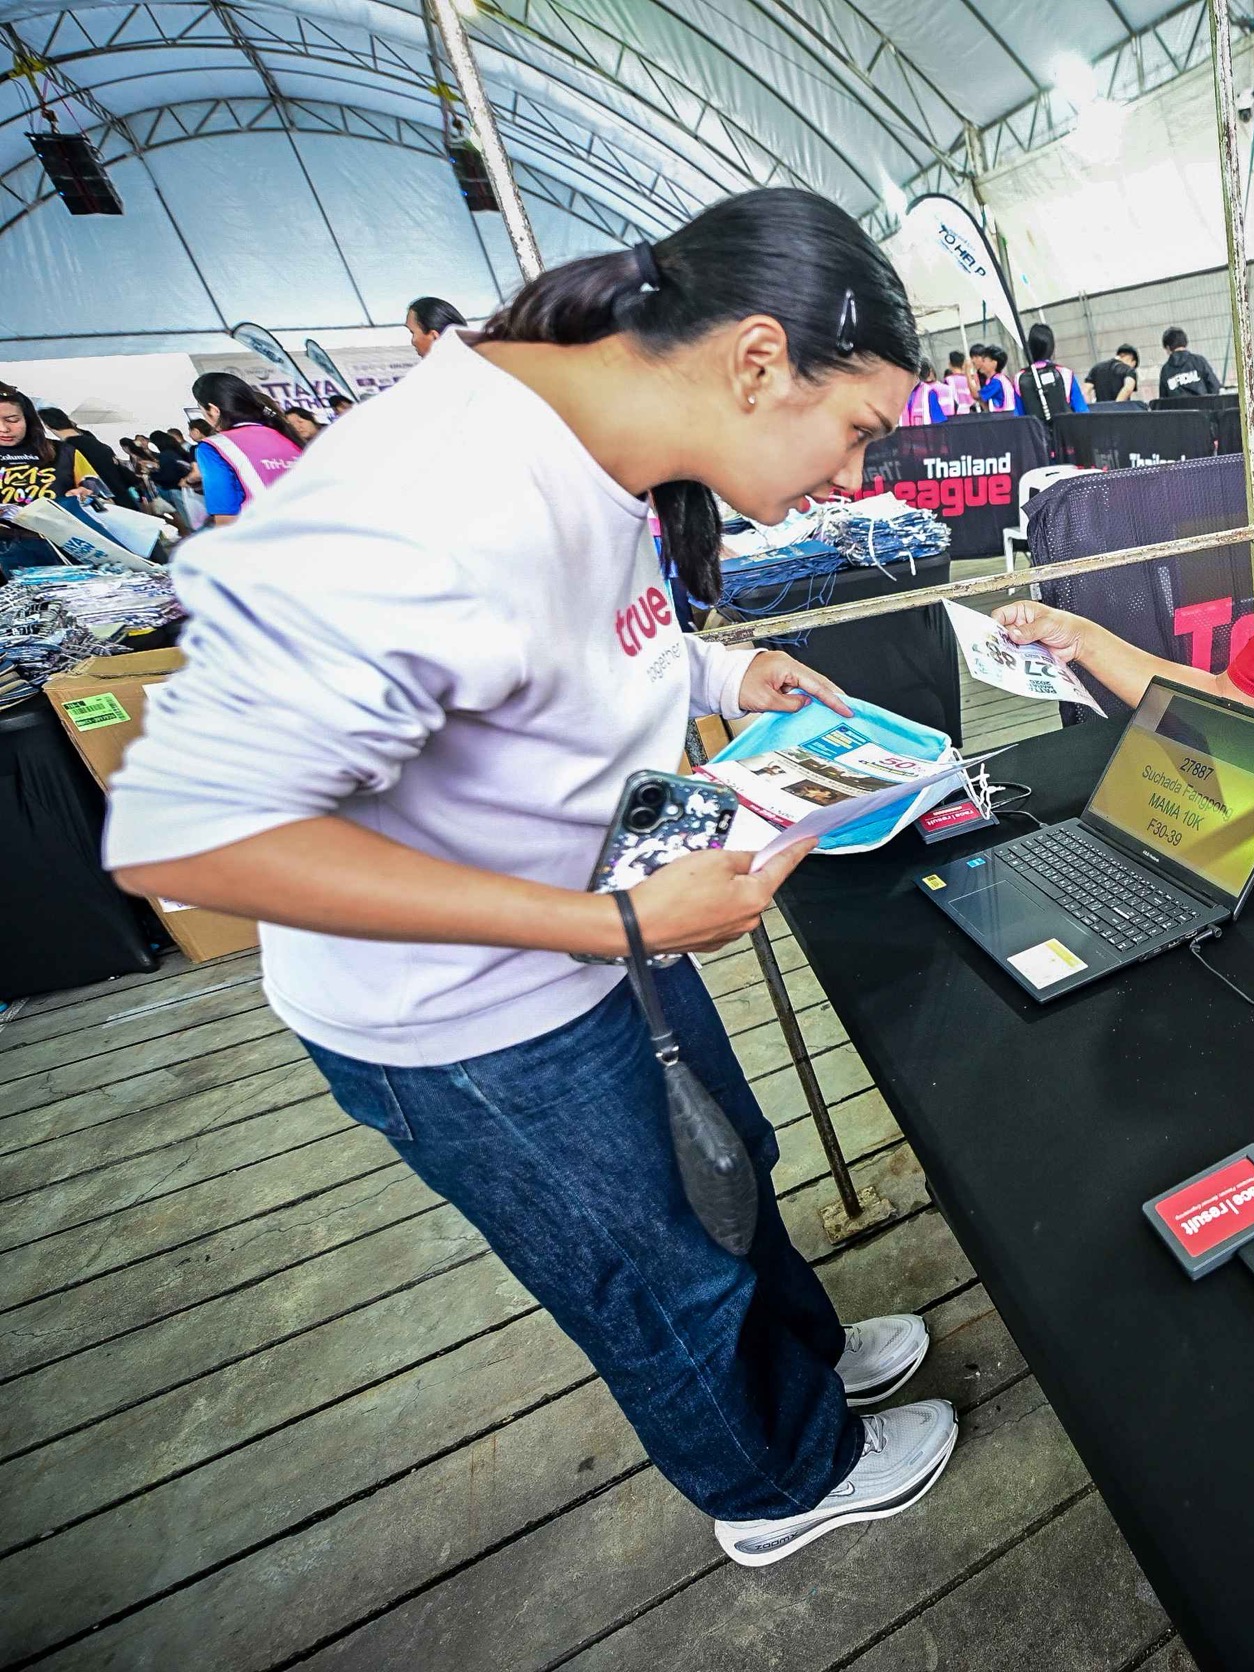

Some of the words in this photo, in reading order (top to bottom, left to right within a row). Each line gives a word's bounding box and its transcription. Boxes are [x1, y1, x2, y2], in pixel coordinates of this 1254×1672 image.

[939, 224, 956, 245] TO
[954, 245, 986, 276] HELP
[251, 380, 341, 399] ATTAYA
[923, 452, 1012, 480] Thailand
[615, 587, 671, 657] true
[1180, 757, 1214, 781] 27887
[1142, 765, 1183, 794] Suchada
[1182, 783, 1234, 823] Fangpong
[1148, 793, 1181, 820] MAMA
[1182, 810, 1205, 831] 10K
[1147, 818, 1183, 847] F30-39
